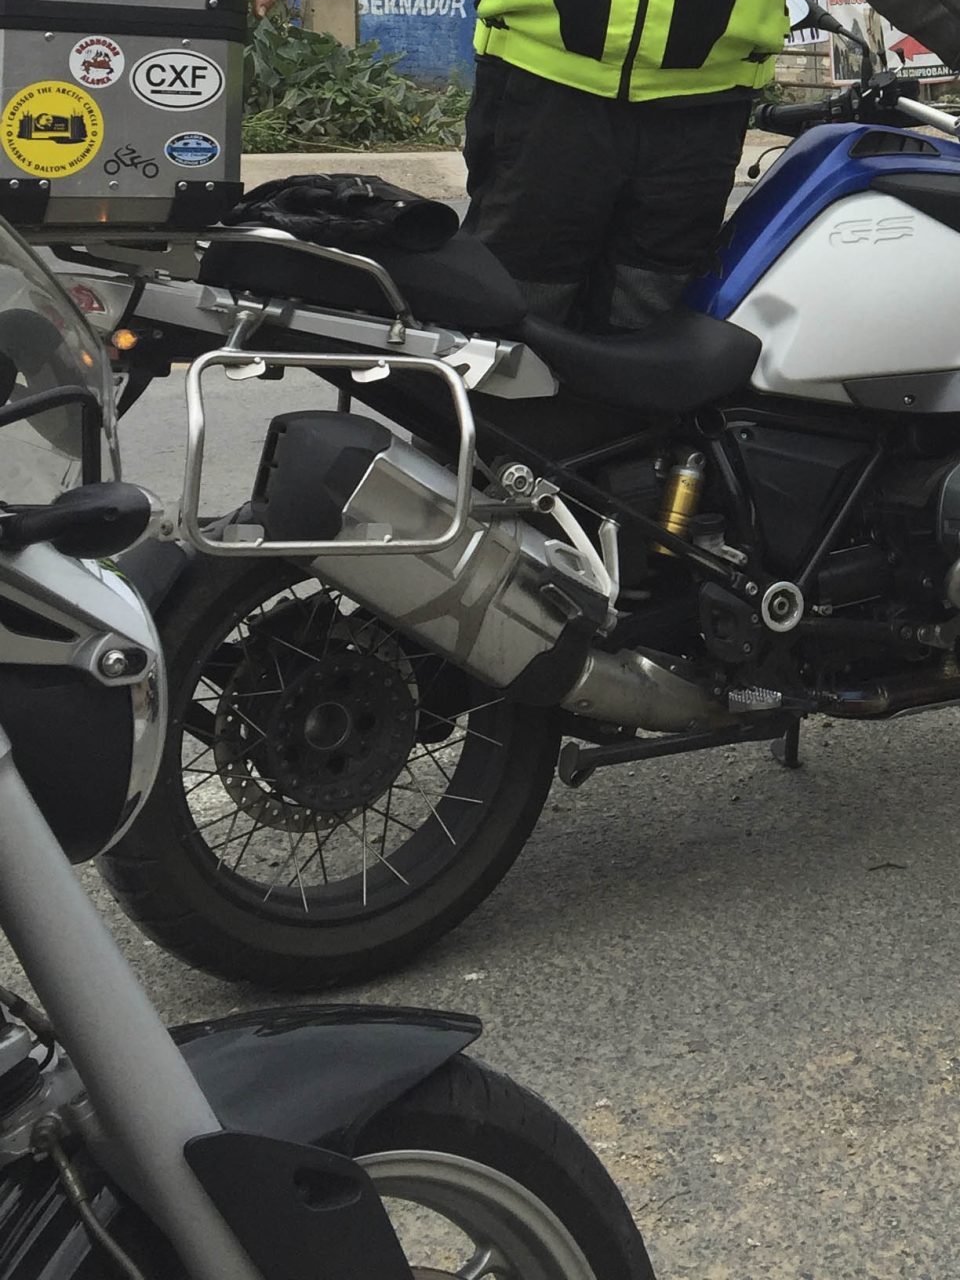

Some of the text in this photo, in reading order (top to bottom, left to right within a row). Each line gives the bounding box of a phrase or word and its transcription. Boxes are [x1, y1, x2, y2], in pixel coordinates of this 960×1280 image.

[146, 63, 208, 89] CXF
[8, 92, 35, 122] CROSSED
[36, 87, 53, 96] THE
[55, 87, 84, 103] ARCTIC
[83, 102, 99, 127] CIRCLE
[6, 138, 97, 173] ALASKA'S DALTON HIGHWAY
[829, 216, 915, 248] GS
